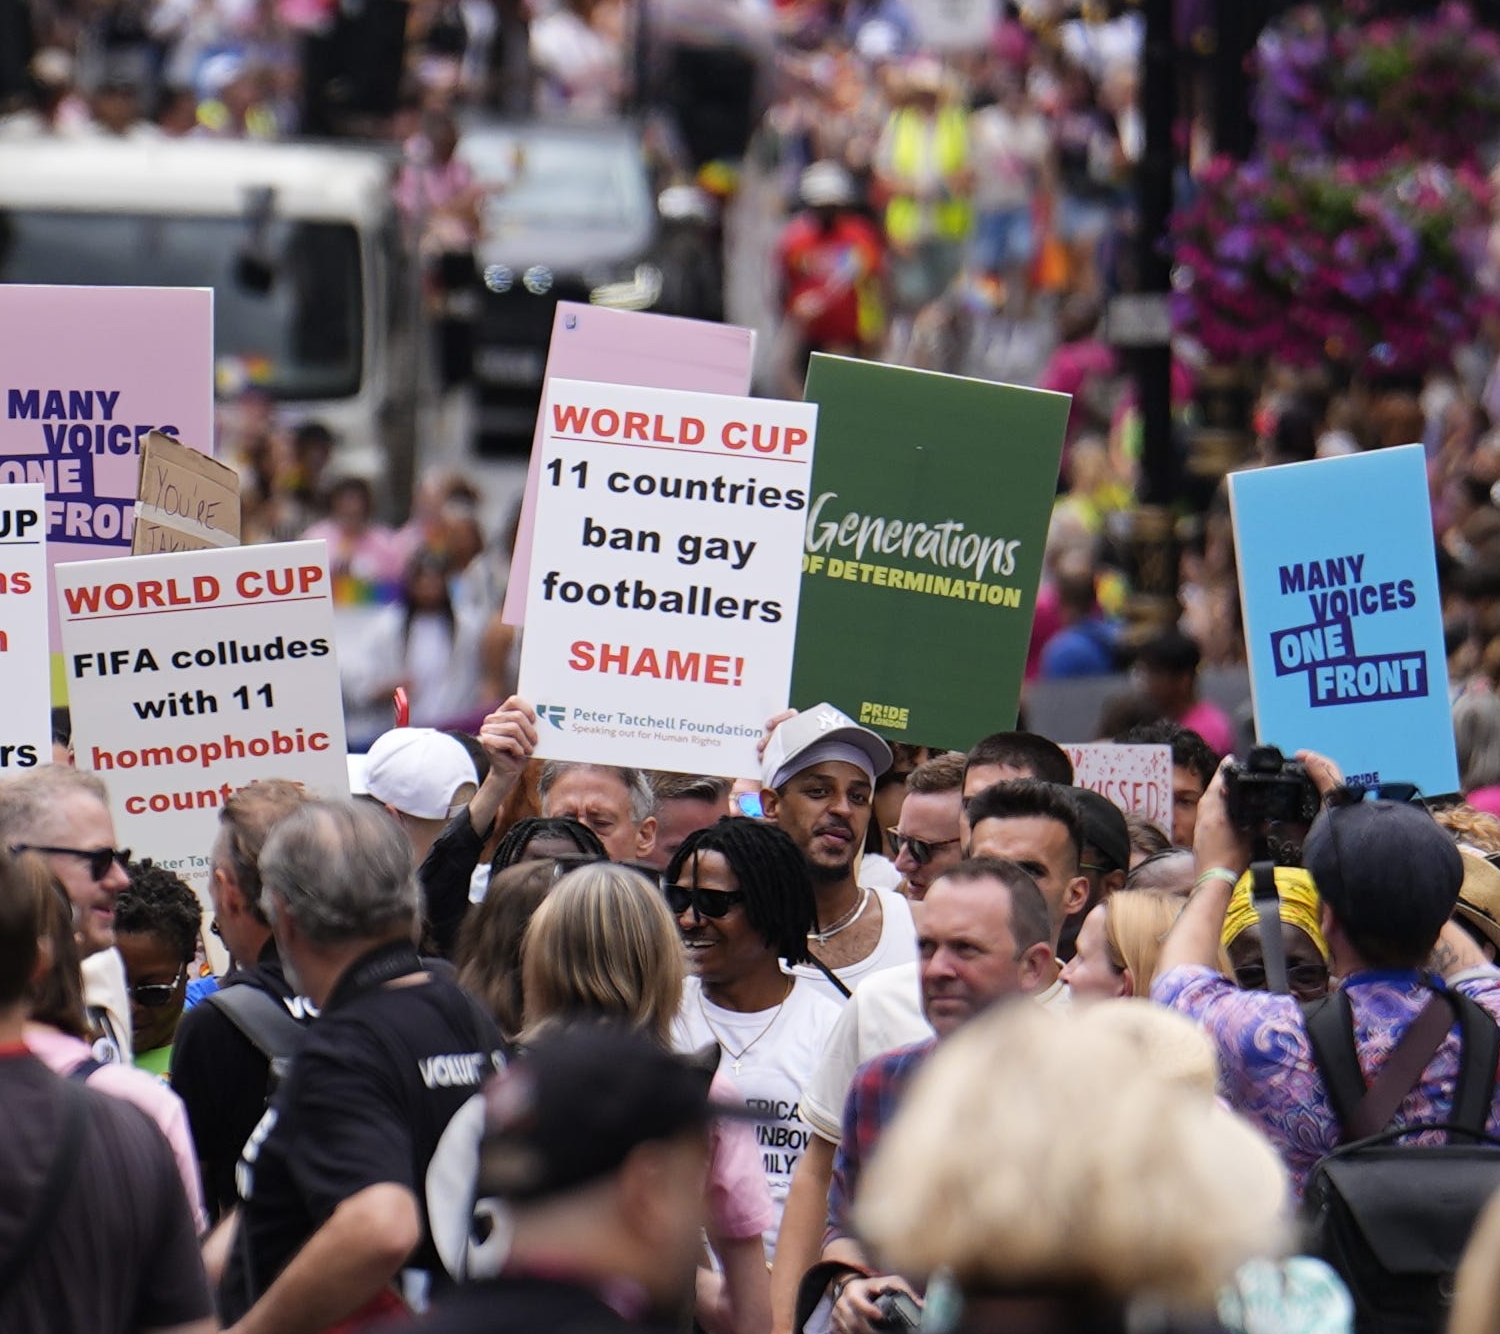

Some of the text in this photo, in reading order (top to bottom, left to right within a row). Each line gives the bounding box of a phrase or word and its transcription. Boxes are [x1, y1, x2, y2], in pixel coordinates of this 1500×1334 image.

[7, 389, 121, 420] MANY
[42, 424, 180, 455] VOIC
[552, 404, 808, 455] WORLD CUP
[153, 466, 223, 531] YOU'RE
[546, 458, 806, 511] 11 countries
[581, 517, 757, 570] ban gay
[805, 491, 1022, 582] Generations
[64, 565, 324, 615] WORLD CUP
[826, 557, 1022, 609] DETERMINATION
[1278, 553, 1366, 596] MANY
[542, 571, 783, 624] footballers
[1308, 579, 1416, 623] VOICES
[73, 636, 330, 679] FIFA colludes
[568, 640, 745, 687] SHAME!
[1278, 623, 1345, 669] ONE
[134, 683, 275, 720] with 11
[1315, 658, 1423, 701] FRONT
[572, 723, 722, 749] Speaking out for Human Rights
[573, 708, 764, 739] Peter Tatchell Foundation
[871, 715, 908, 730] LONDON
[91, 728, 330, 771] homophobic
